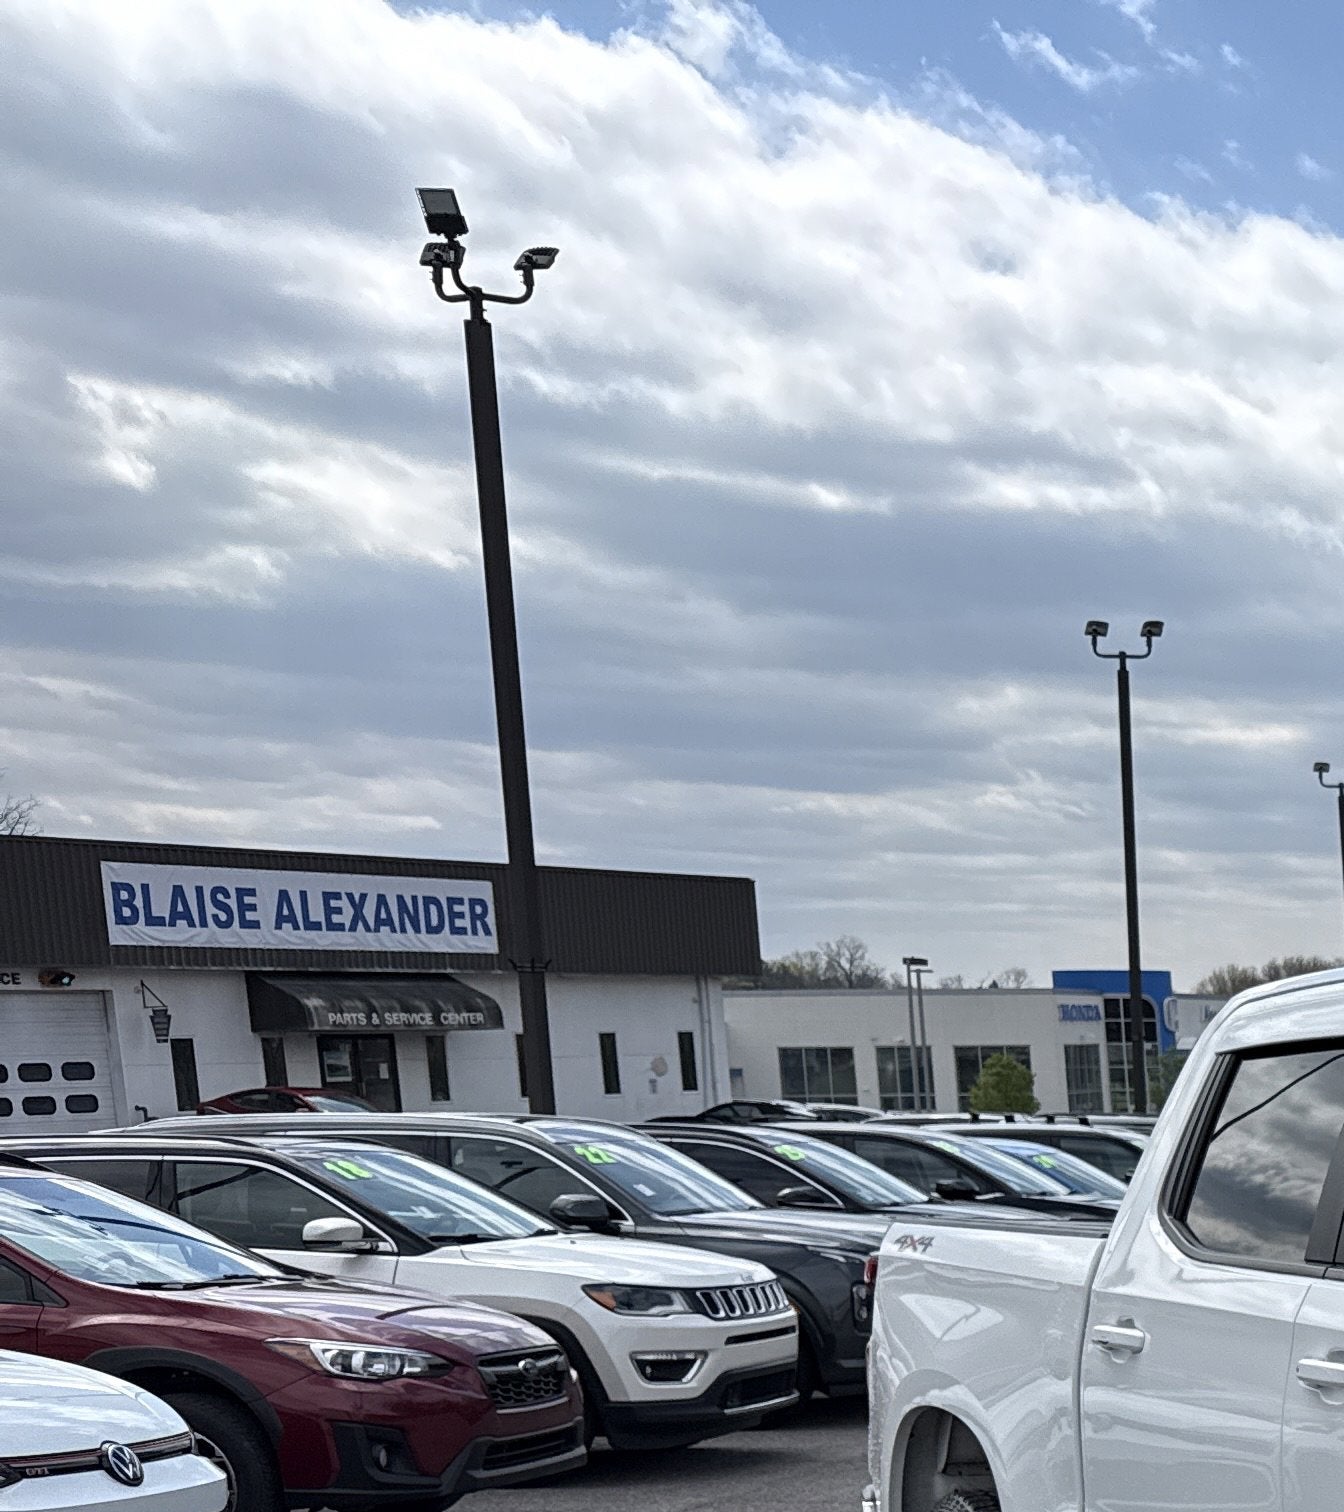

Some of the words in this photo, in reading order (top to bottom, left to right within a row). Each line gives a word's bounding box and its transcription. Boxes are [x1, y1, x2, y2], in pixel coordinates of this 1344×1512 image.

[110, 881, 261, 930] BLAISE
[273, 889, 493, 937] ALEXANDER
[328, 1012, 367, 1026] PARTS
[371, 1012, 380, 1025] &
[385, 1012, 434, 1026] SERVICE
[440, 1012, 485, 1025] CENTER
